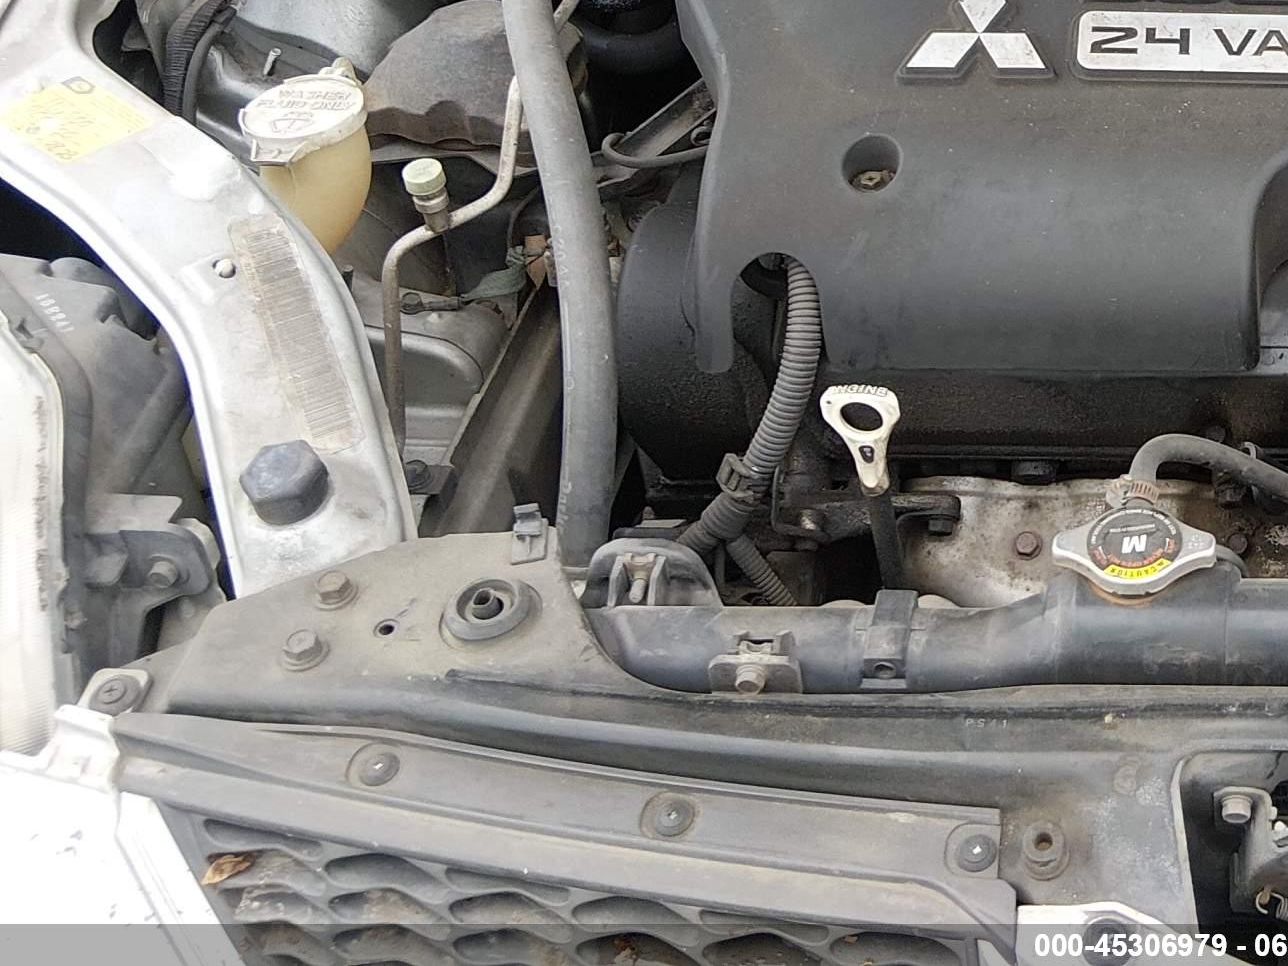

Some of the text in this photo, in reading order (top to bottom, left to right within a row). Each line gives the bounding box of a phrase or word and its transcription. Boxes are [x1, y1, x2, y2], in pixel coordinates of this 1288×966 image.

[1089, 25, 1192, 55] 24
[255, 99, 358, 111] FLUID ONLY
[1121, 534, 1148, 554] M
[1110, 566, 1158, 577] CAUTION
